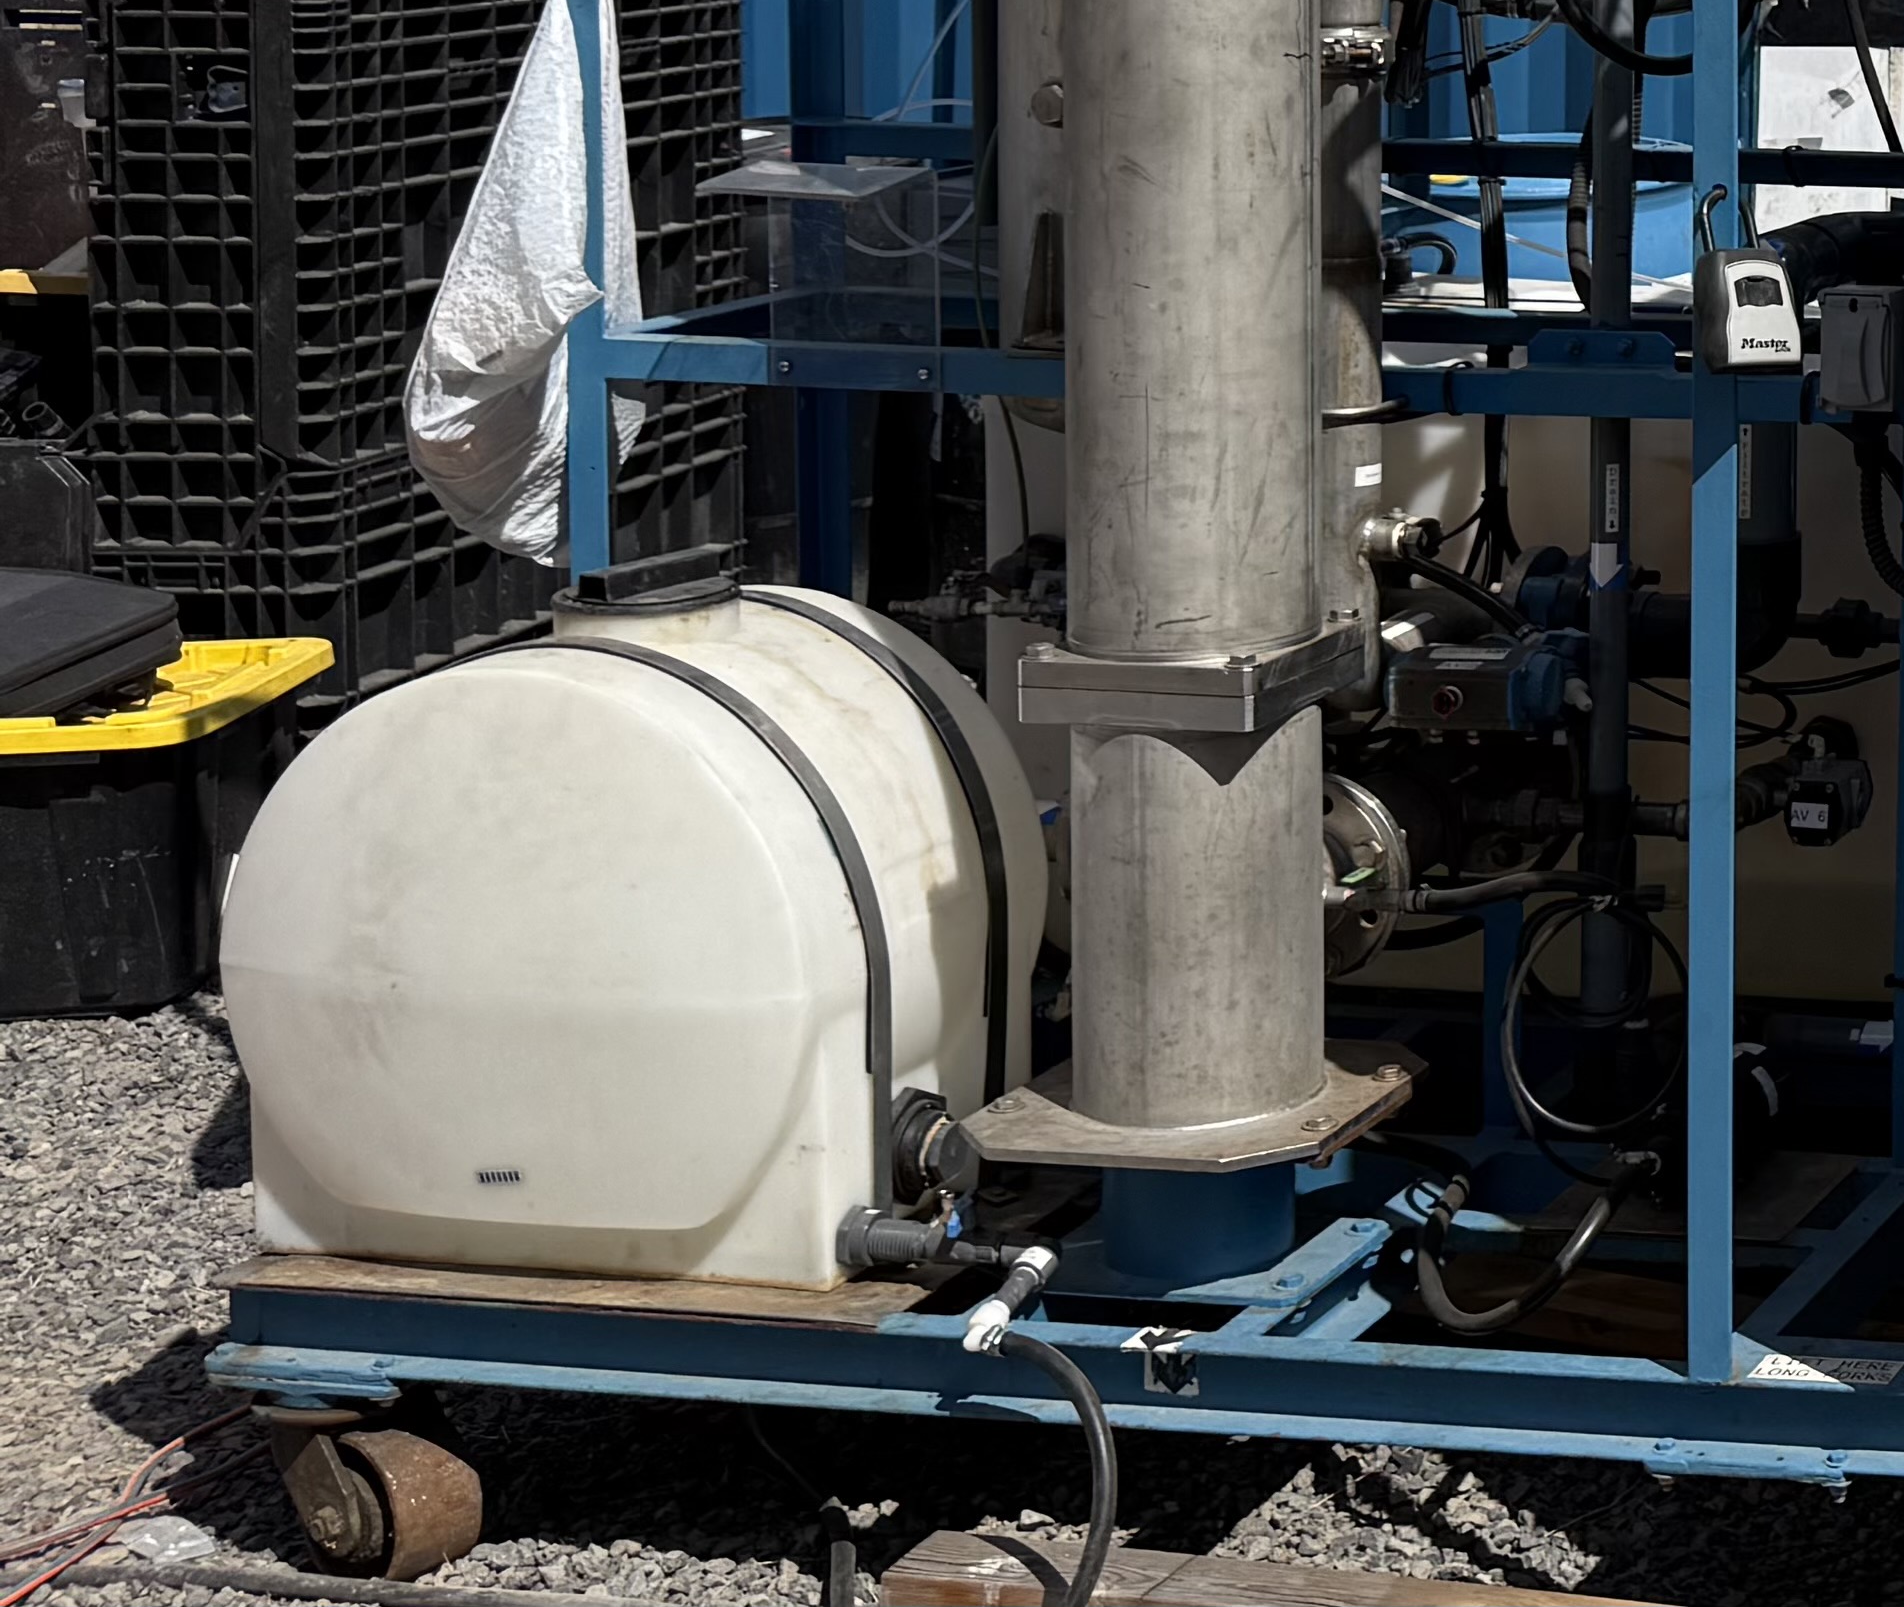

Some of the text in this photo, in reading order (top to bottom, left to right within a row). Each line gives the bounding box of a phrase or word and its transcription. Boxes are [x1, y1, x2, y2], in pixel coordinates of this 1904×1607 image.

[1741, 338, 1789, 350] Master
[1791, 809, 1826, 822] AV 6
